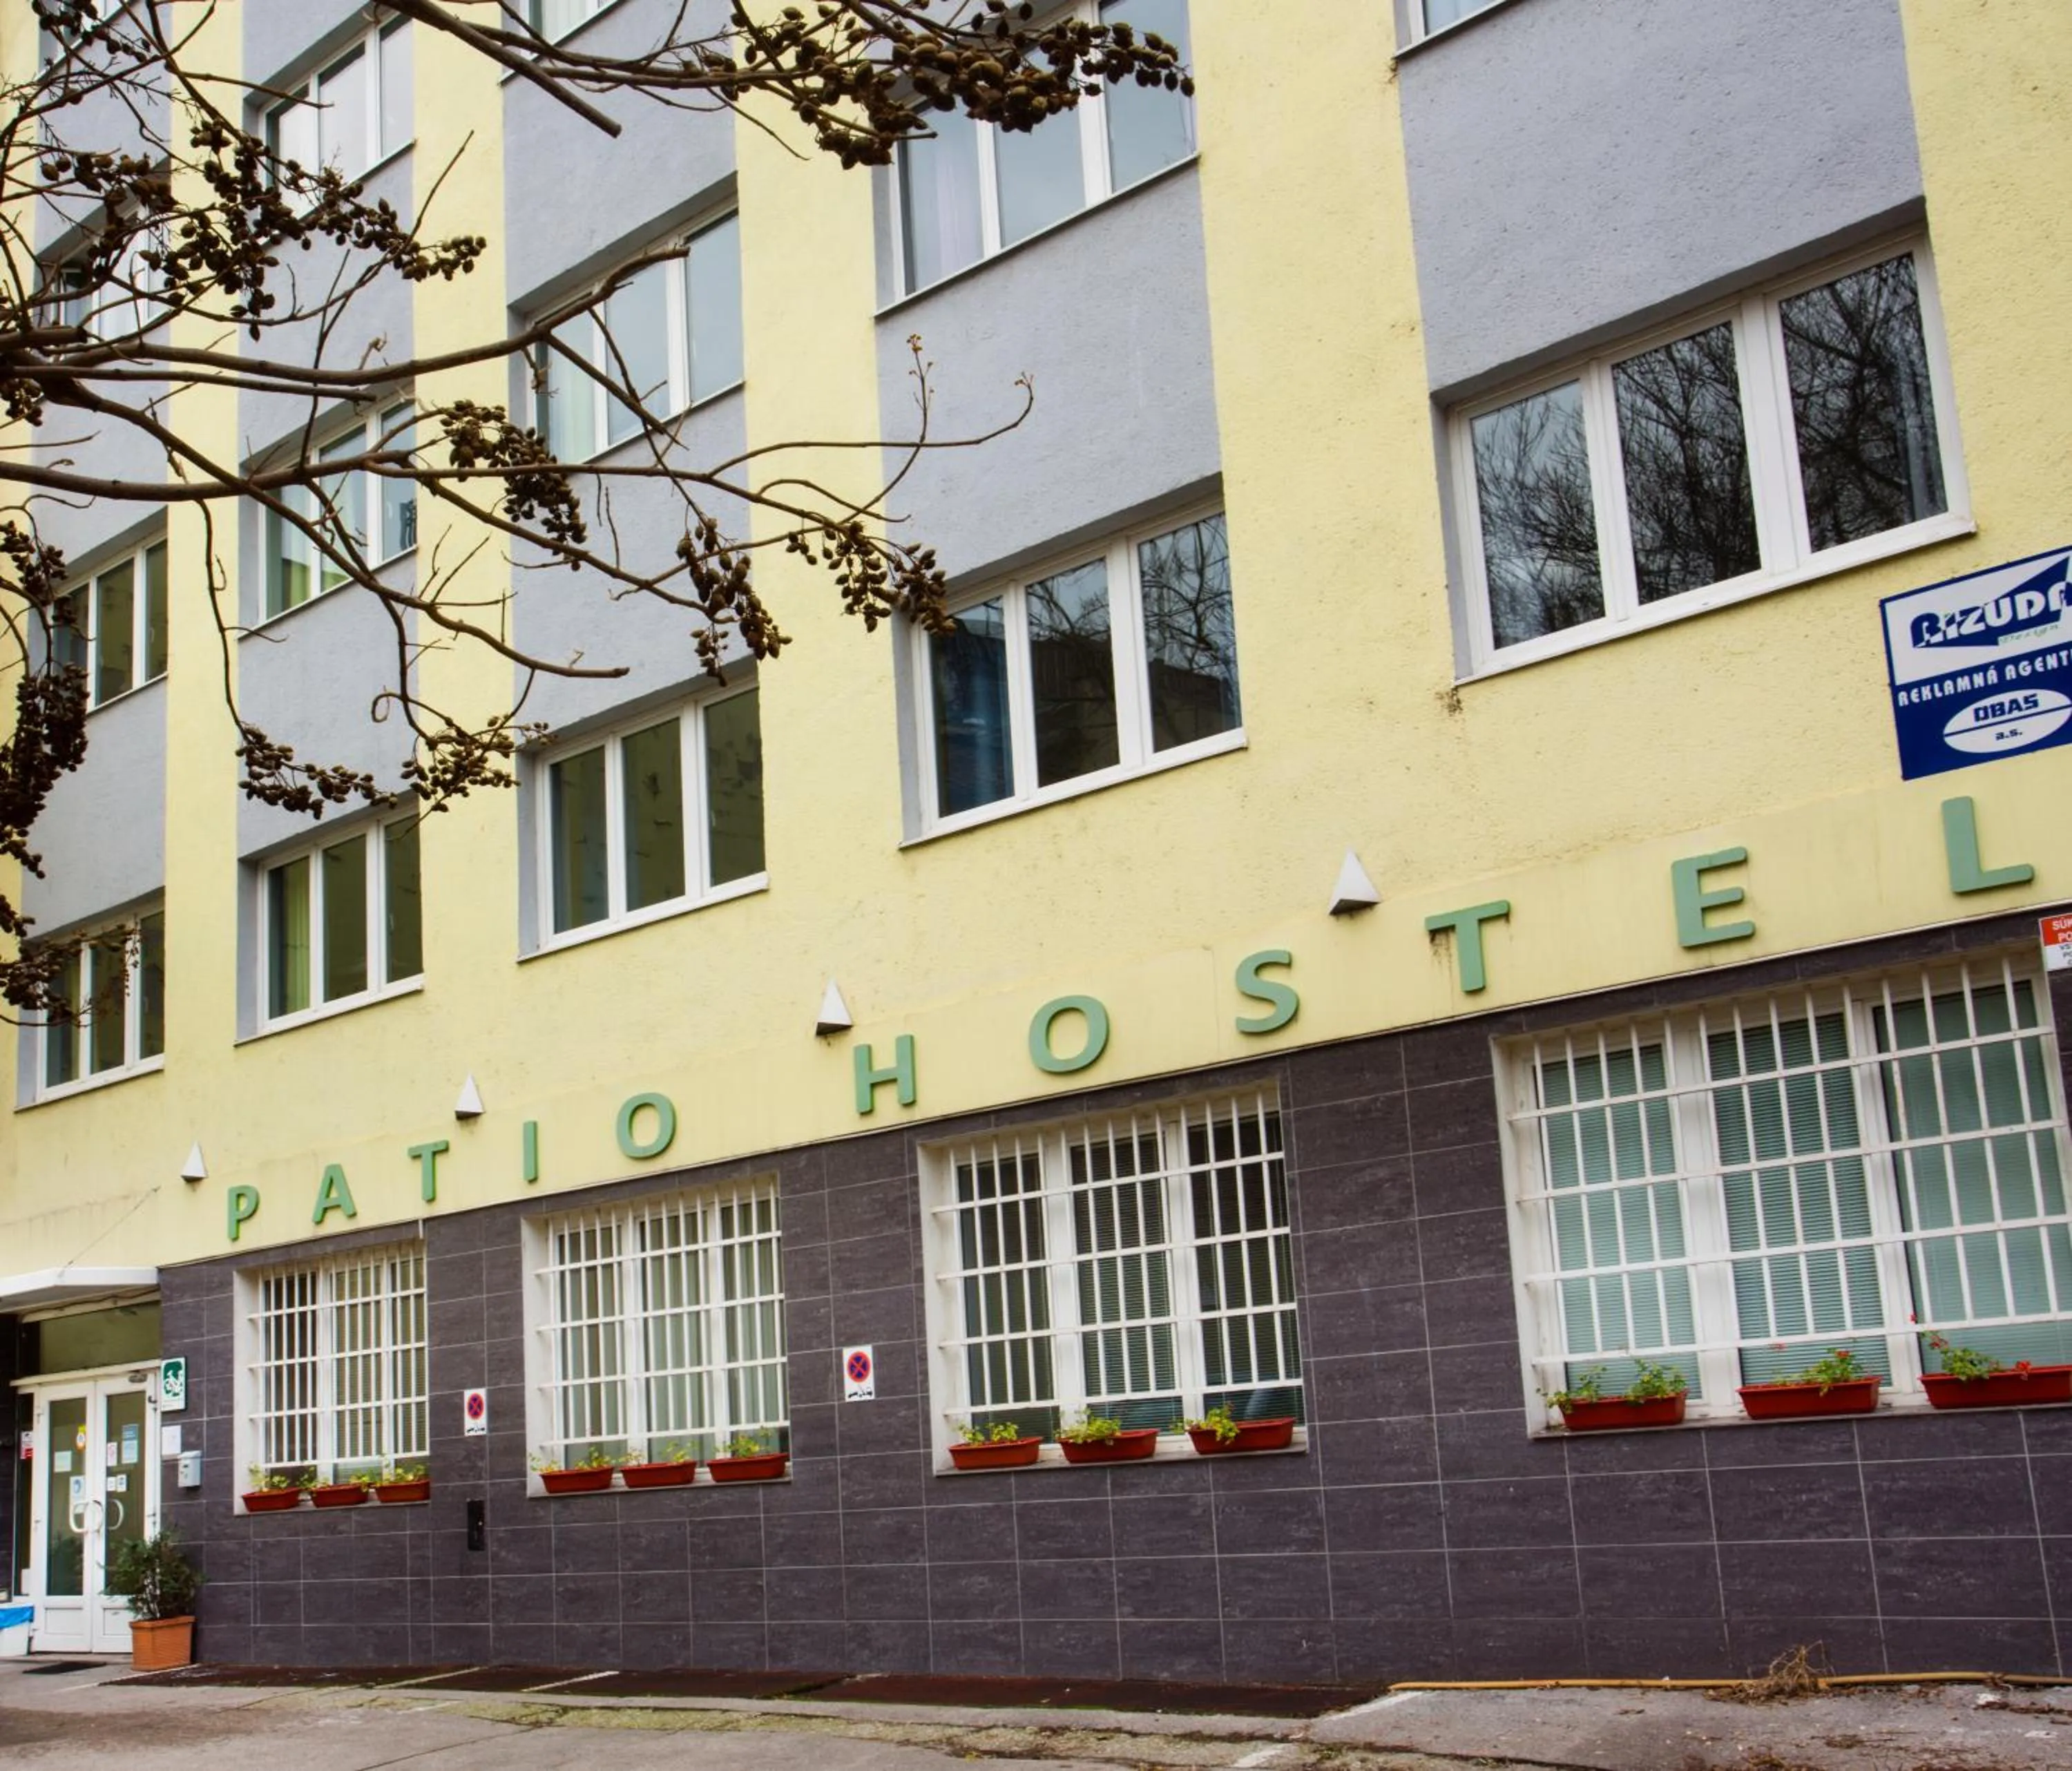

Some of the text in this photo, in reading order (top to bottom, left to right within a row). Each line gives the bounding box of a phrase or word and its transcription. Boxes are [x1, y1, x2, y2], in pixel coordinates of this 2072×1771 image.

[1898, 649, 2072, 707] REKLAMNÁ AGENT
[1995, 728, 2023, 741] a.s.
[227, 795, 2035, 1241] PATIO HOSTEL
